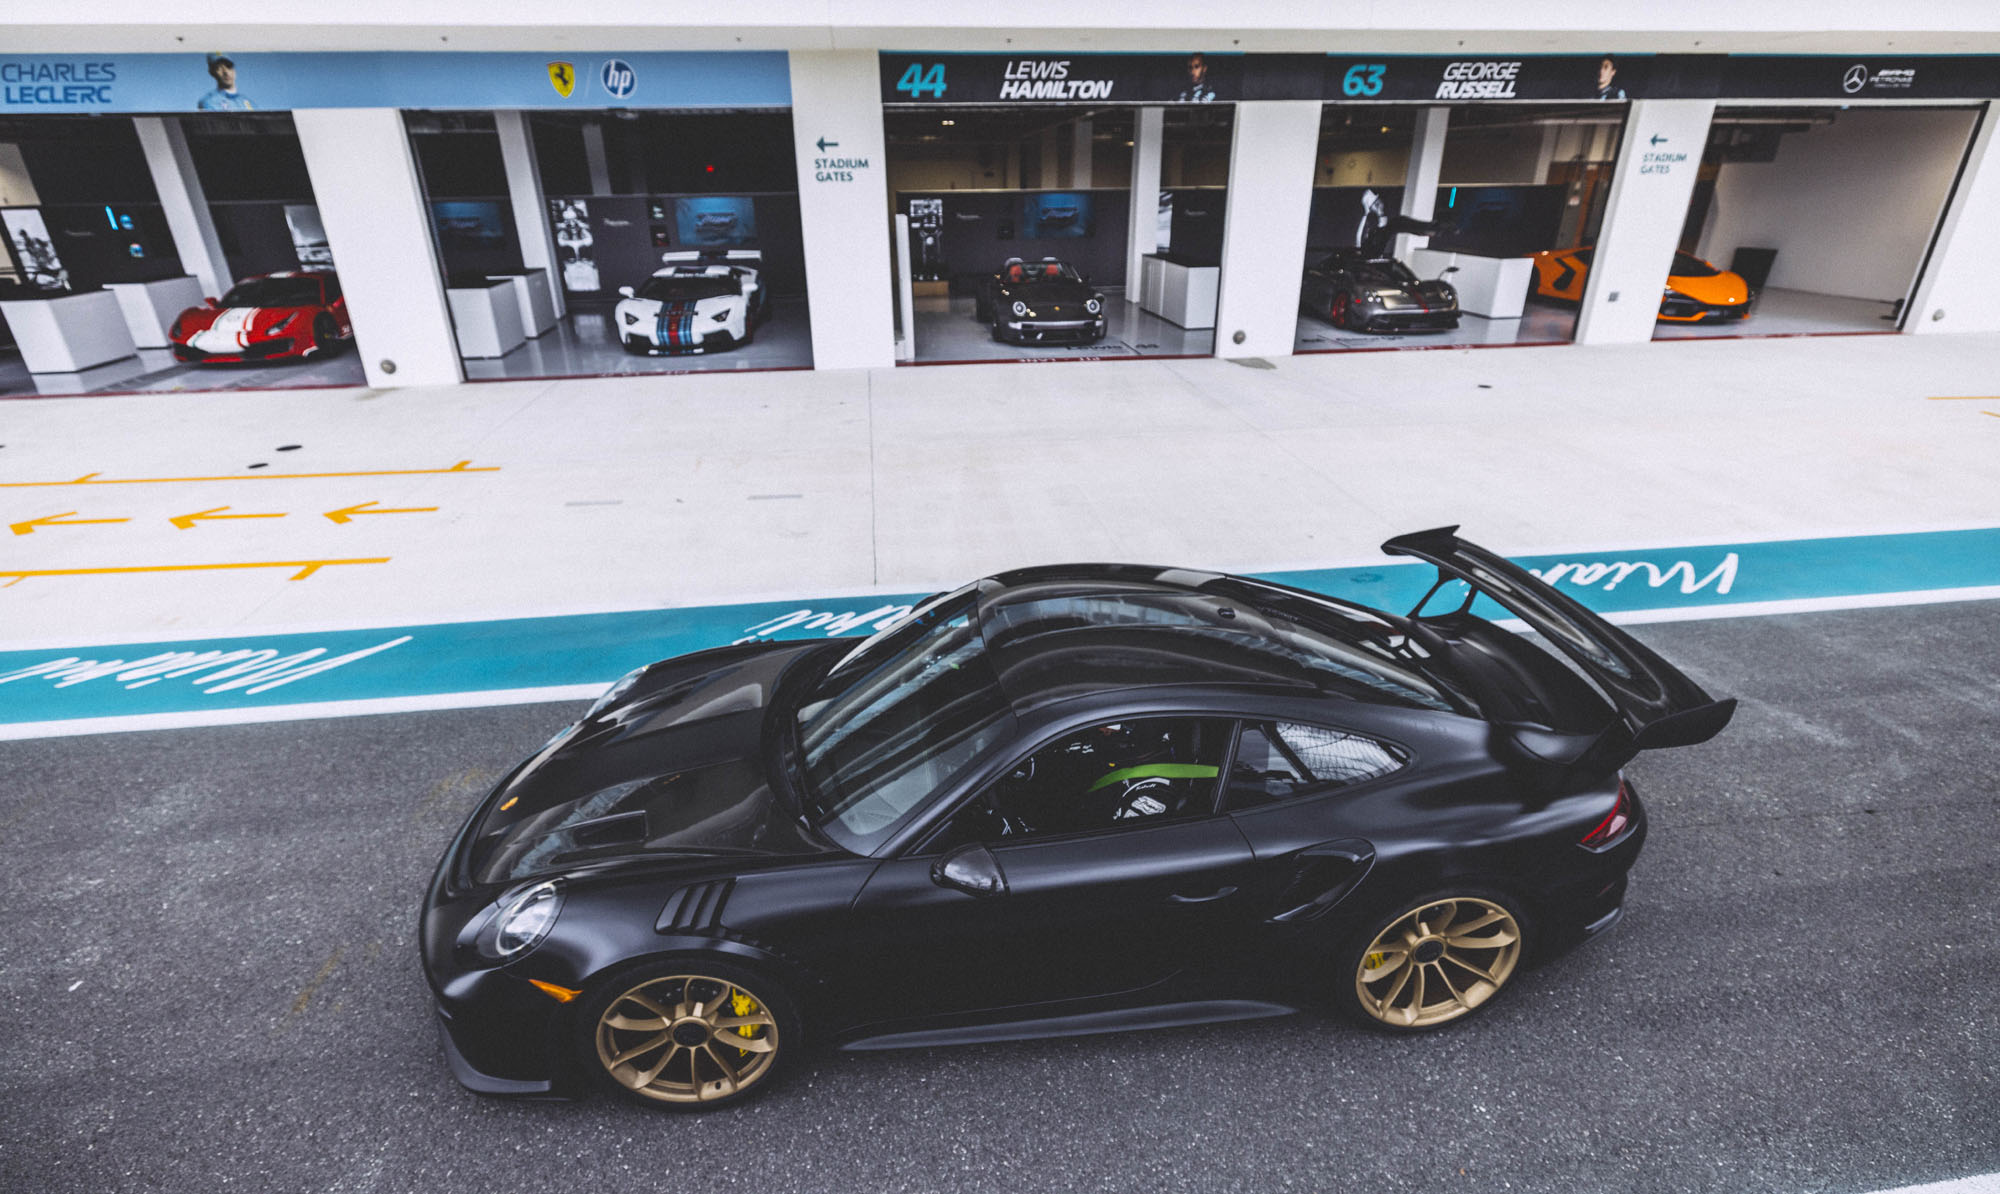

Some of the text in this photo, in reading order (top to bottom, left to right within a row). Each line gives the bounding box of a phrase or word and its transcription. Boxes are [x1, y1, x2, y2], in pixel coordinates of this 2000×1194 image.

[2, 62, 116, 82] CHARLES
[607, 60, 632, 98] hp
[1004, 61, 1070, 80] LEWIS
[1443, 62, 1522, 81] GEORGE
[897, 63, 947, 98] 44
[1000, 80, 1113, 100] HAMILTON
[1343, 64, 1386, 97] 63
[1435, 81, 1517, 99] RUSSELL
[5, 85, 112, 104] LECLERC
[815, 158, 869, 169] STADIUM
[1643, 152, 1688, 162] STADIUM
[815, 171, 853, 182] GATES
[1640, 164, 1670, 174] GATES
